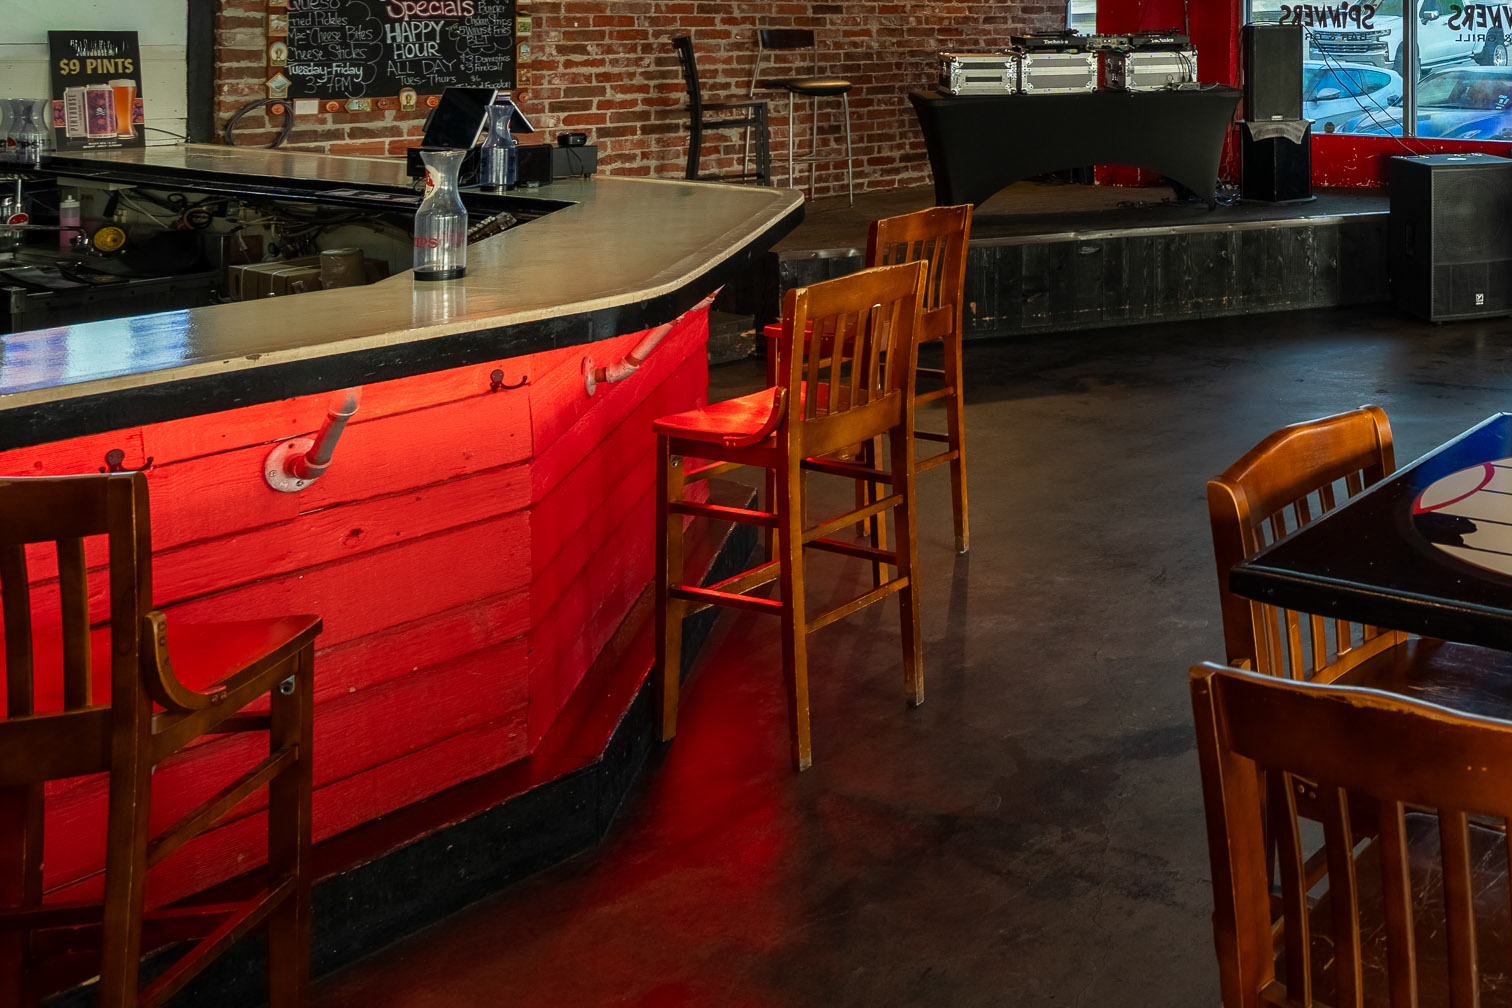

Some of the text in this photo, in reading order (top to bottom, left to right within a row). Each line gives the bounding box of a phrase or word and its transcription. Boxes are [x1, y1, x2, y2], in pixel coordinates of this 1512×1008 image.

[314, 11, 348, 26] Pickles
[488, 14, 512, 28] Strips
[345, 25, 373, 43] Bites
[384, 20, 445, 44] HAPPY
[287, 43, 368, 61] Cheese Sticks
[394, 42, 442, 59] HOUR
[60, 58, 134, 75] $9 PINTS
[387, 59, 457, 76] ALL DAY
